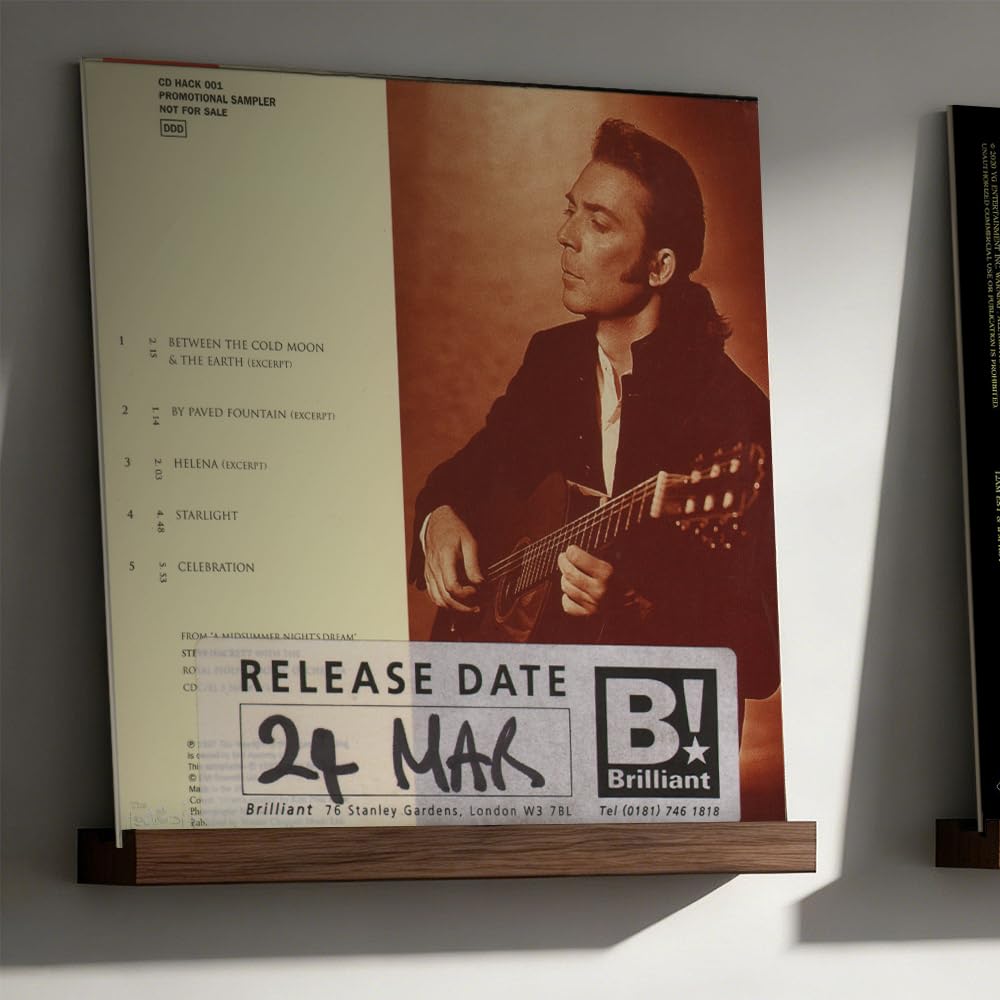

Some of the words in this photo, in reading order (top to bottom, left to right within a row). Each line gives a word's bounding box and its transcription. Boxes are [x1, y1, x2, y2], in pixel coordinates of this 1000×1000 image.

[158, 78, 172, 87] CD
[175, 79, 201, 89] HACK
[204, 80, 223, 90] 001
[159, 91, 228, 104] PROMOTIONAL
[231, 95, 276, 107] SAMPLER
[159, 105, 178, 114] NOT
[182, 106, 201, 116] FOR
[204, 107, 228, 117] SALE
[163, 124, 184, 133] DDD
[119, 336, 124, 346] 1
[168, 337, 221, 350] BETWEEN
[225, 339, 248, 350] THE
[251, 340, 283, 352] COLD
[287, 342, 324, 353] MOON
[168, 355, 177, 366] &
[180, 356, 203, 366] THE
[207, 357, 243, 367] EARTH
[247, 358, 292, 369] (EXCERPT)
[121, 406, 128, 415] 2
[171, 407, 184, 417] BY
[188, 407, 223, 418] PAVED
[227, 408, 286, 419] FOUNTAIN
[290, 410, 336, 421] (EXCERPT)
[124, 458, 131, 468] 3
[174, 458, 218, 469] HELENA
[221, 459, 267, 470] (EXCERPT)
[126, 510, 133, 519] 4
[175, 510, 239, 521] STARLIGHT
[129, 562, 135, 571] 5
[177, 561, 255, 573] CELEBRATION
[181, 632, 207, 640] FROM
[240, 659, 433, 695] RELEASE
[459, 663, 566, 697] DATE
[258, 714, 359, 805] 24
[393, 713, 545, 792] MAR
[608, 768, 711, 790] Brilliant
[246, 803, 313, 816] Brilliant
[325, 804, 341, 816] 76
[349, 804, 397, 818] Stanley
[403, 804, 462, 818] Gardens,
[470, 805, 517, 817] London
[524, 806, 543, 817] W3
[550, 806, 572, 817] 7BL
[600, 805, 617, 817] Tel
[622, 805, 660, 818] (0181)
[666, 806, 686, 817] 746
[692, 806, 720, 817] 1818
